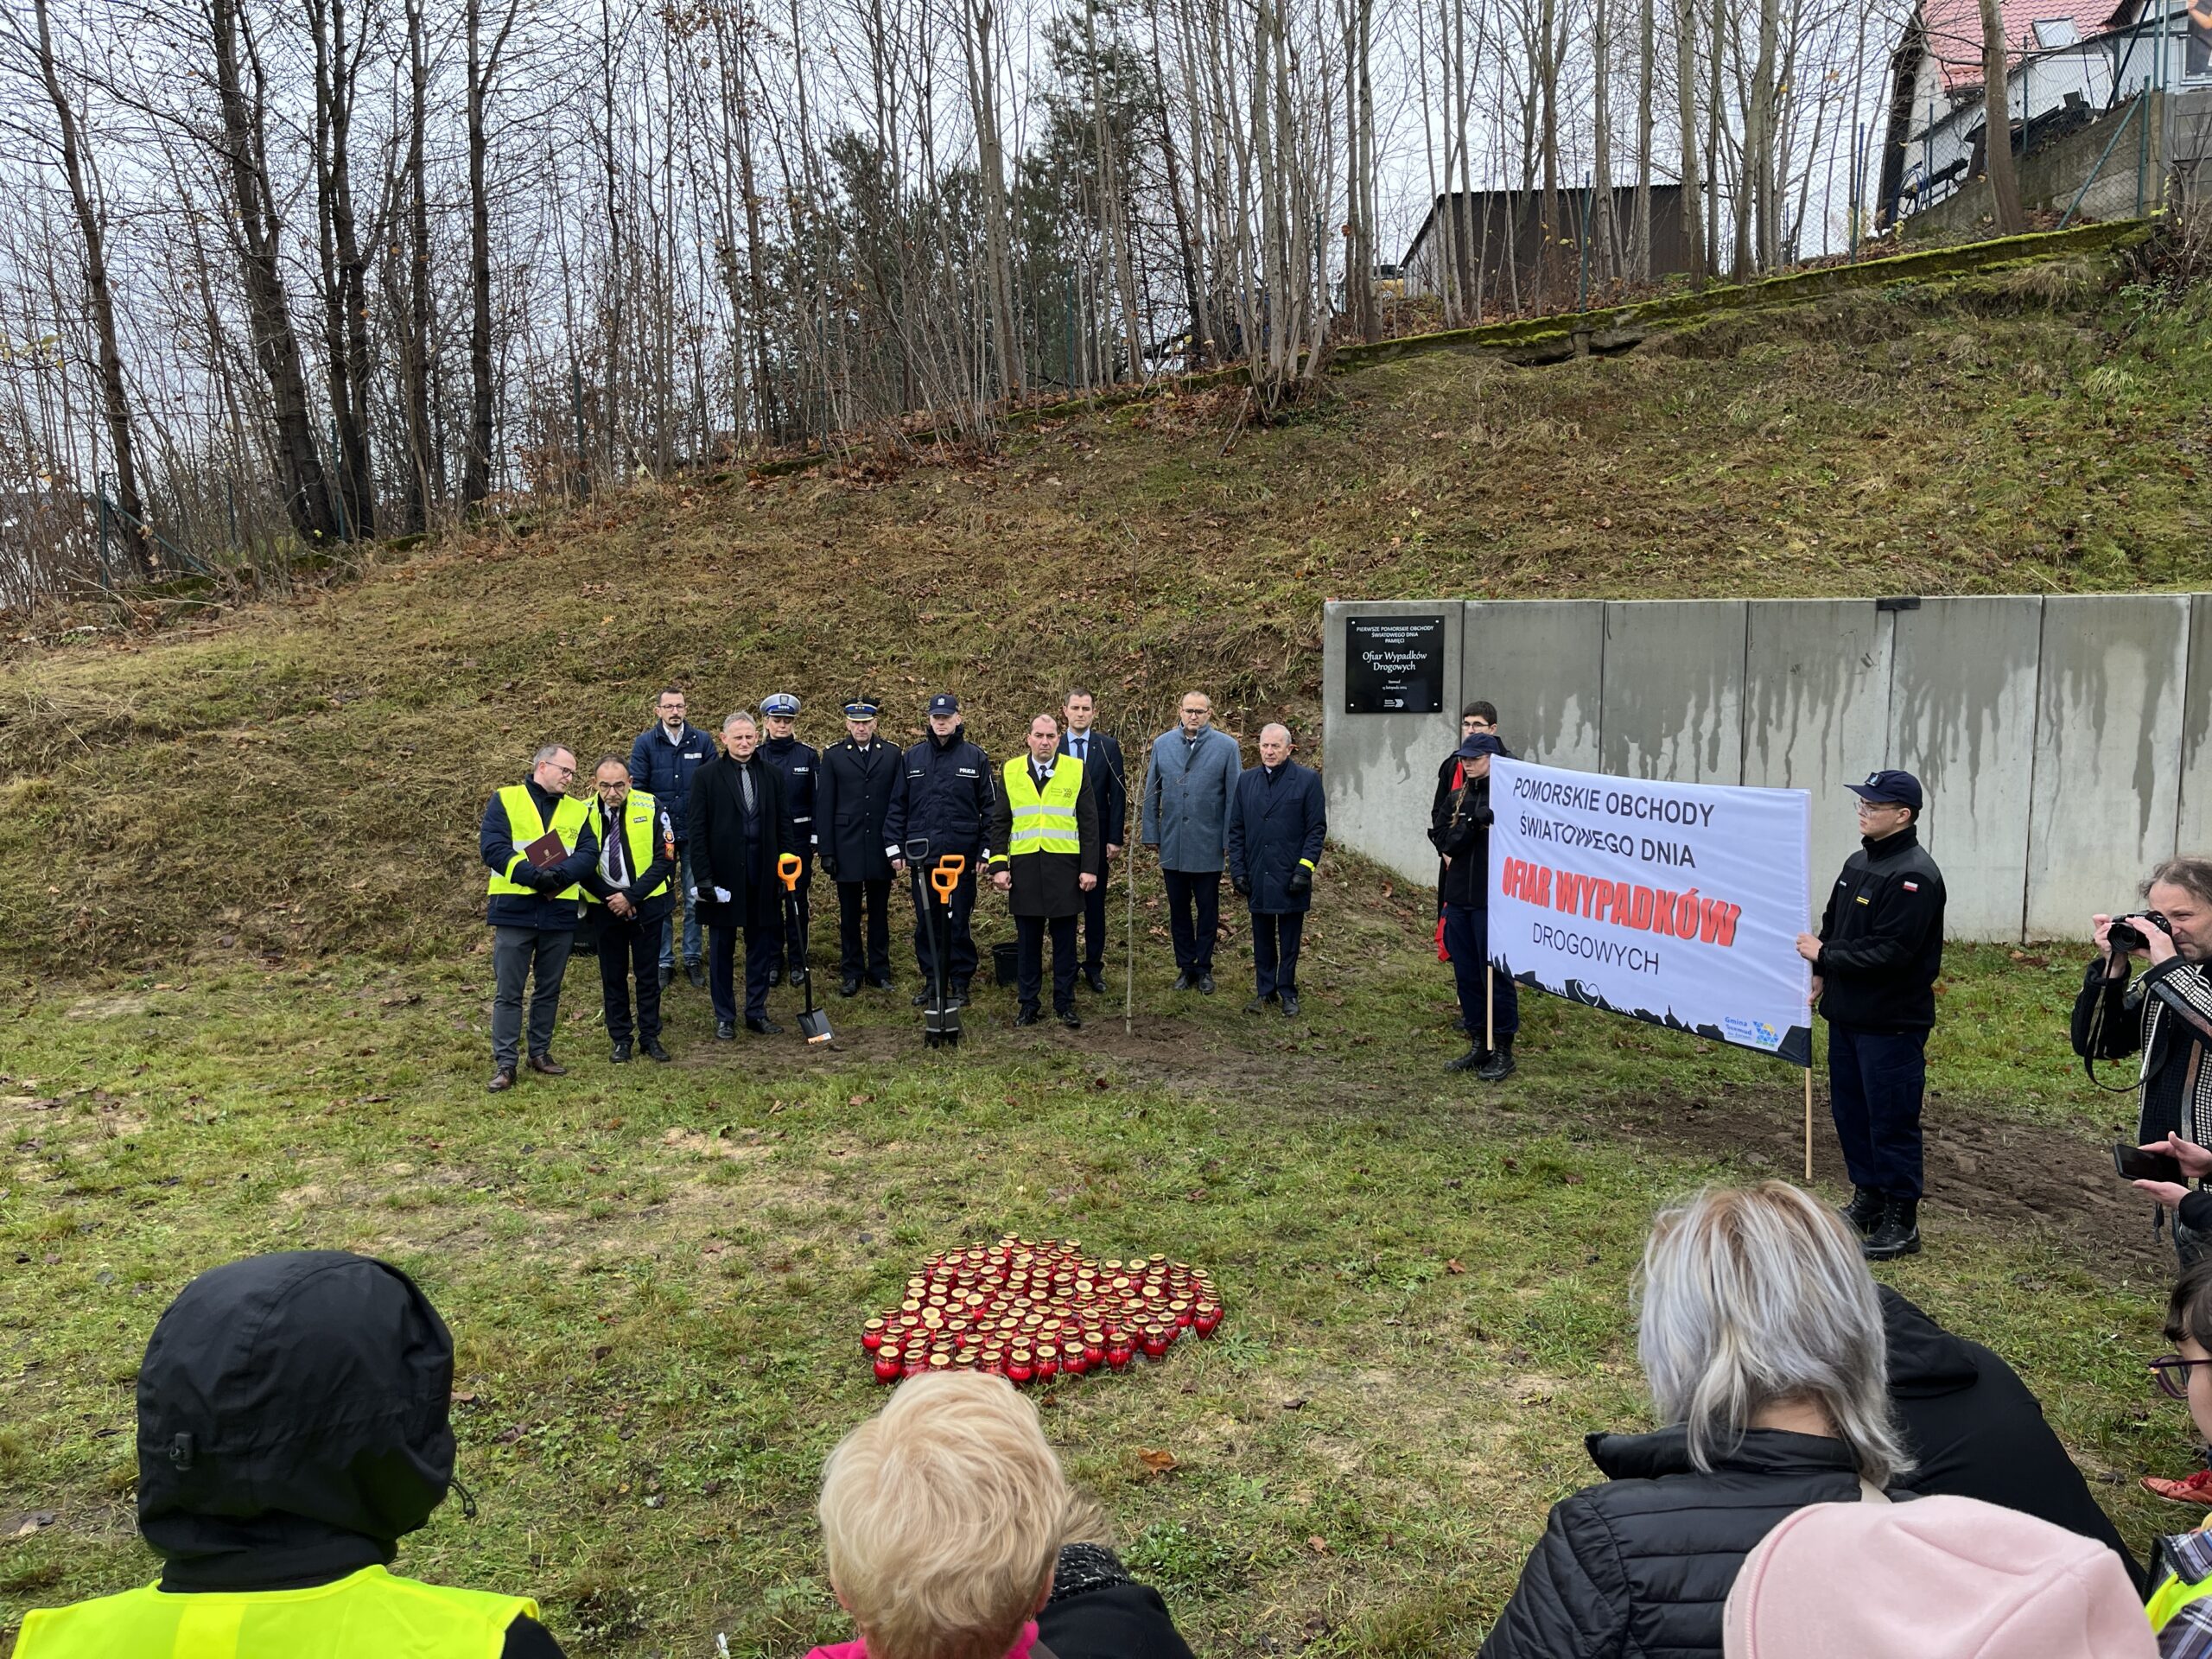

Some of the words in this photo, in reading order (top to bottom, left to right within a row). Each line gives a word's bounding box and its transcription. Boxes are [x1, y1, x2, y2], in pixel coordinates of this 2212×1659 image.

[1363, 651, 1382, 663] Ofiar
[1384, 650, 1427, 663] Wypadków
[1373, 661, 1415, 672] Drogowych
[1512, 777, 1600, 812] POMORSKIE
[1605, 791, 1715, 827] OBCHODY
[1520, 810, 1634, 857] ŚWIATOWEGO
[1641, 838, 1695, 868] DNIA
[1502, 856, 1551, 907] OFIAR
[1555, 869, 1742, 947] WYPADKÓW
[1532, 922, 1659, 976] DROGOWYCH
[1725, 1016, 1747, 1027] Gmina
